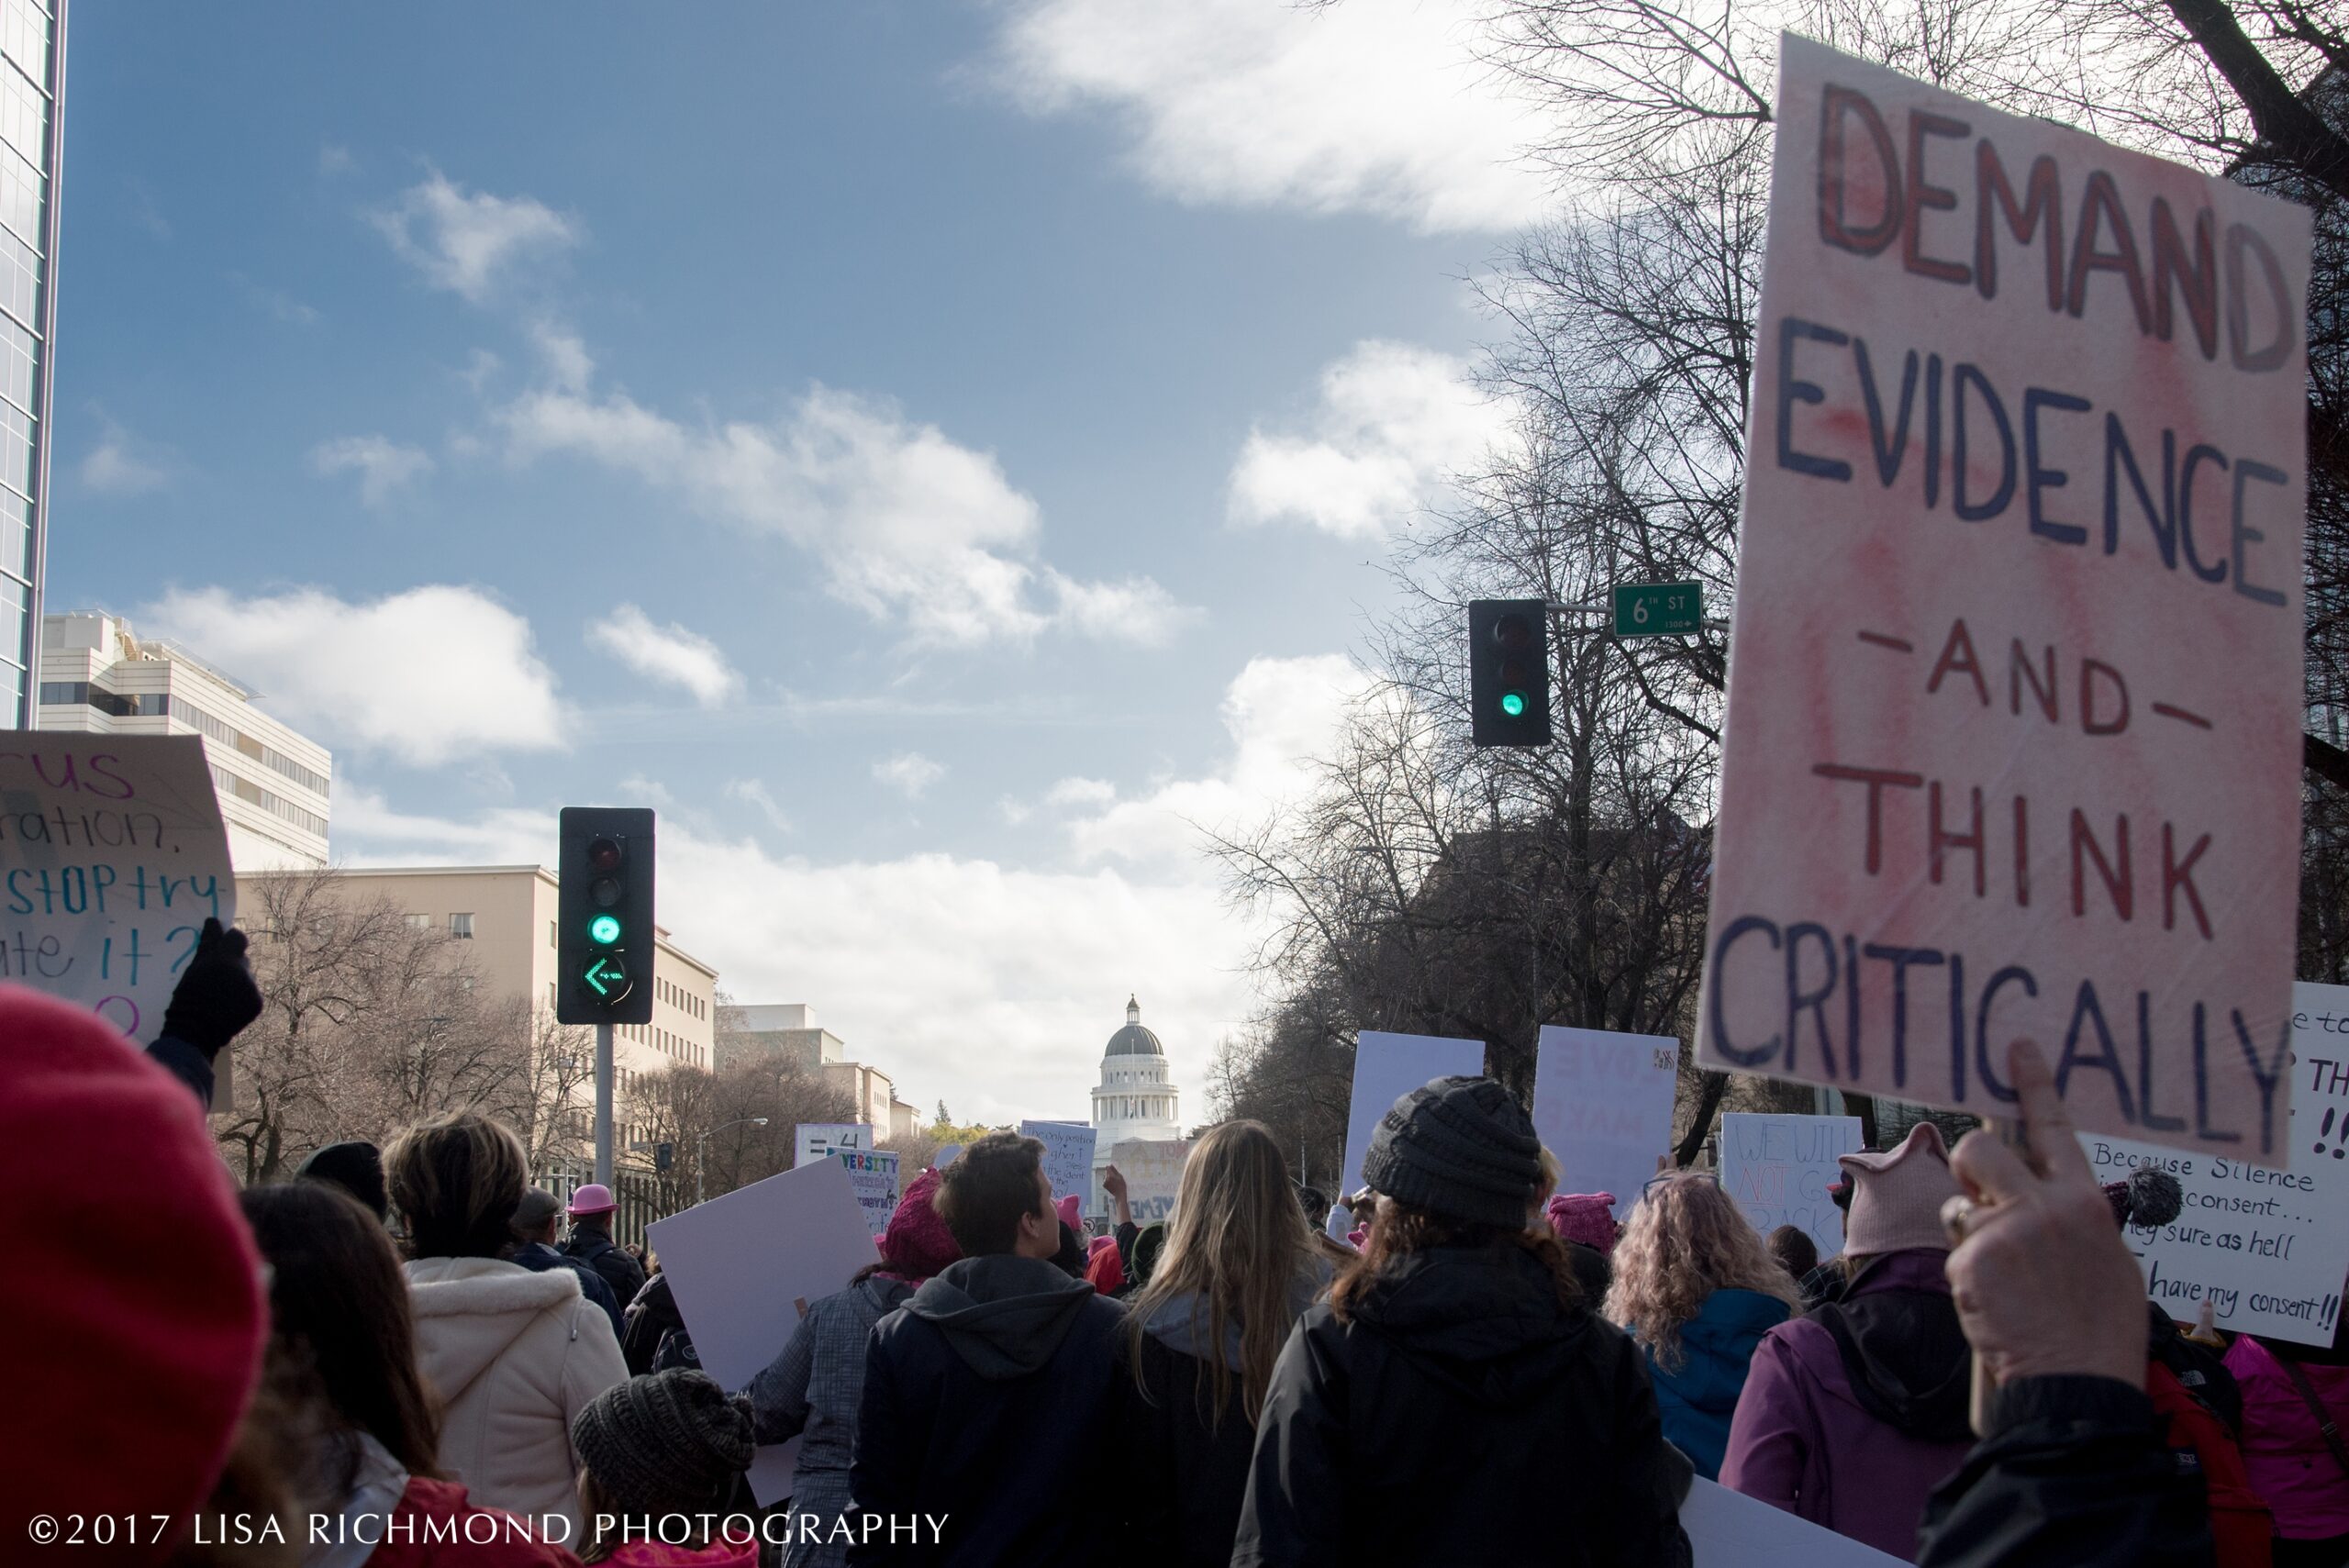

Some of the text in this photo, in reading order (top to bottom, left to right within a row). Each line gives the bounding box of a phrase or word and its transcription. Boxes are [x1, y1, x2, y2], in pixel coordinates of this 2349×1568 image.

[1816, 83, 2294, 373] DEMAND
[1776, 316, 2288, 606] EVIDENCE
[1668, 595, 1686, 610] ST
[1812, 762, 2214, 940] THINK
[1711, 916, 2292, 1156] CRITICALLY
[1735, 1121, 1787, 1162] WE
[1739, 1164, 1794, 1203] NOT
[2211, 1157, 2315, 1192] Silence
[2163, 1225, 2212, 1247] sure
[2216, 1233, 2243, 1251] as
[2248, 1230, 2297, 1262] hell
[2148, 1260, 2202, 1302] have
[2208, 1286, 2240, 1318] my
